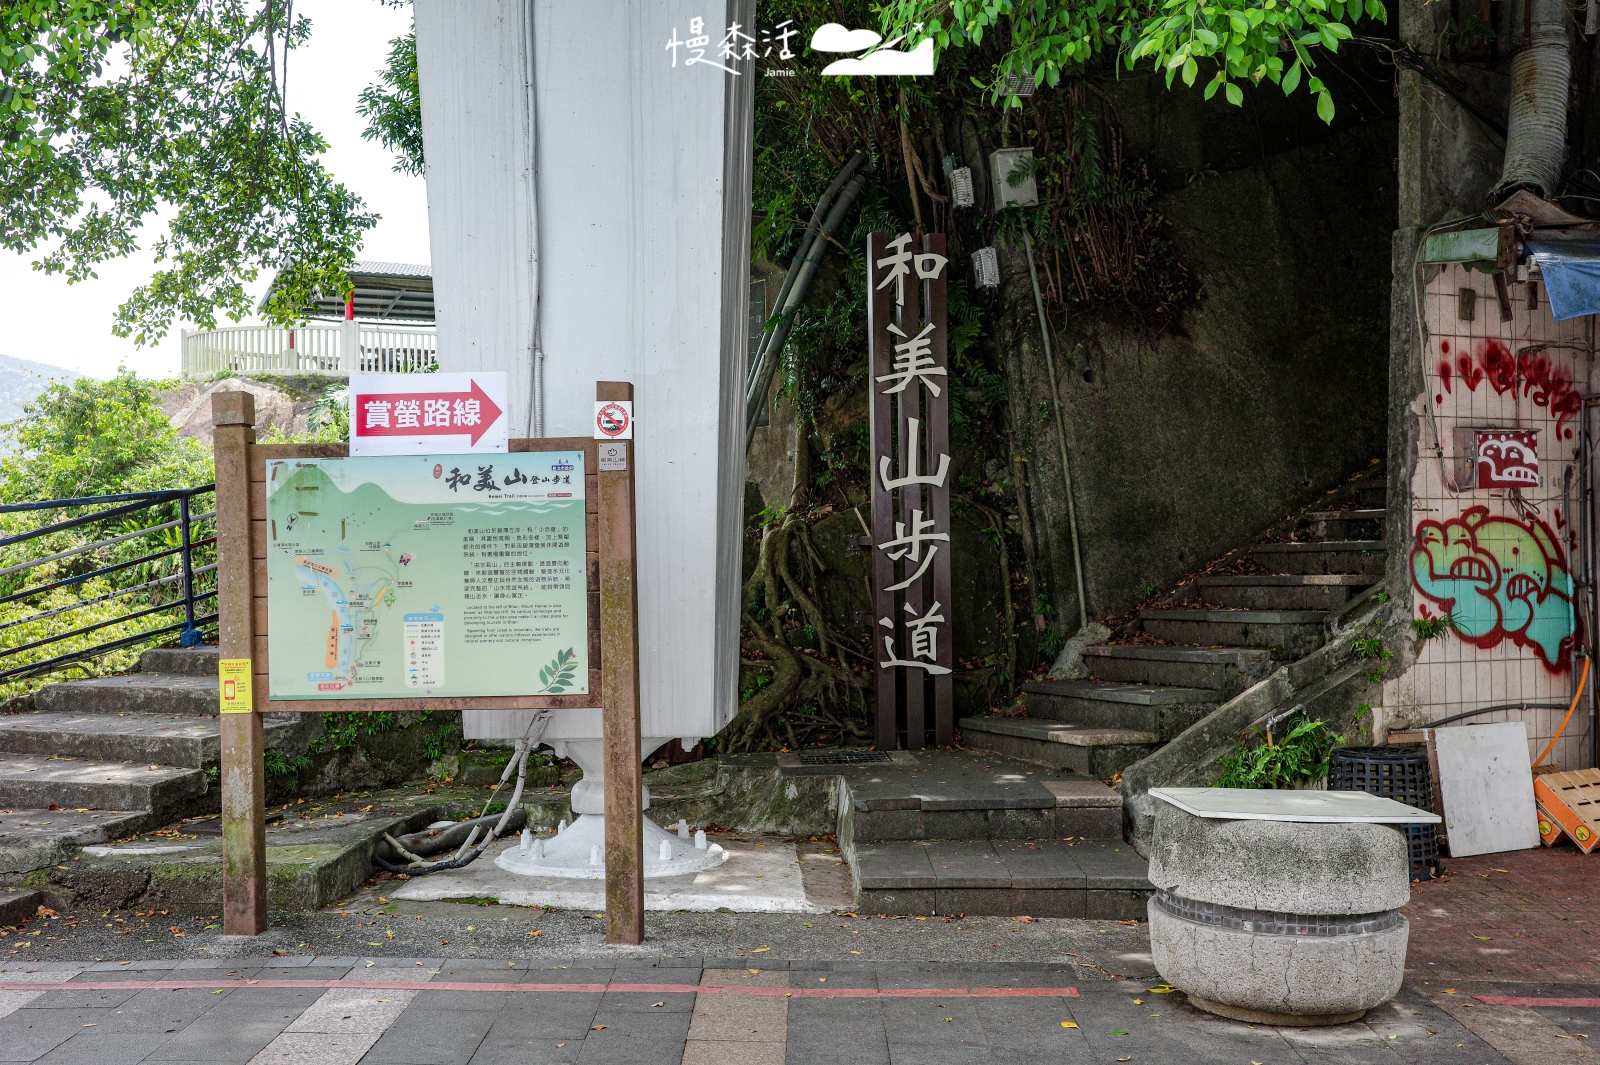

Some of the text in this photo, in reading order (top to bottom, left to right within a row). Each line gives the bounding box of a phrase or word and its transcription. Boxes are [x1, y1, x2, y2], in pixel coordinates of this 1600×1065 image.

[363, 399, 482, 428] 賞螢路線
[875, 231, 953, 676] 和美山步道
